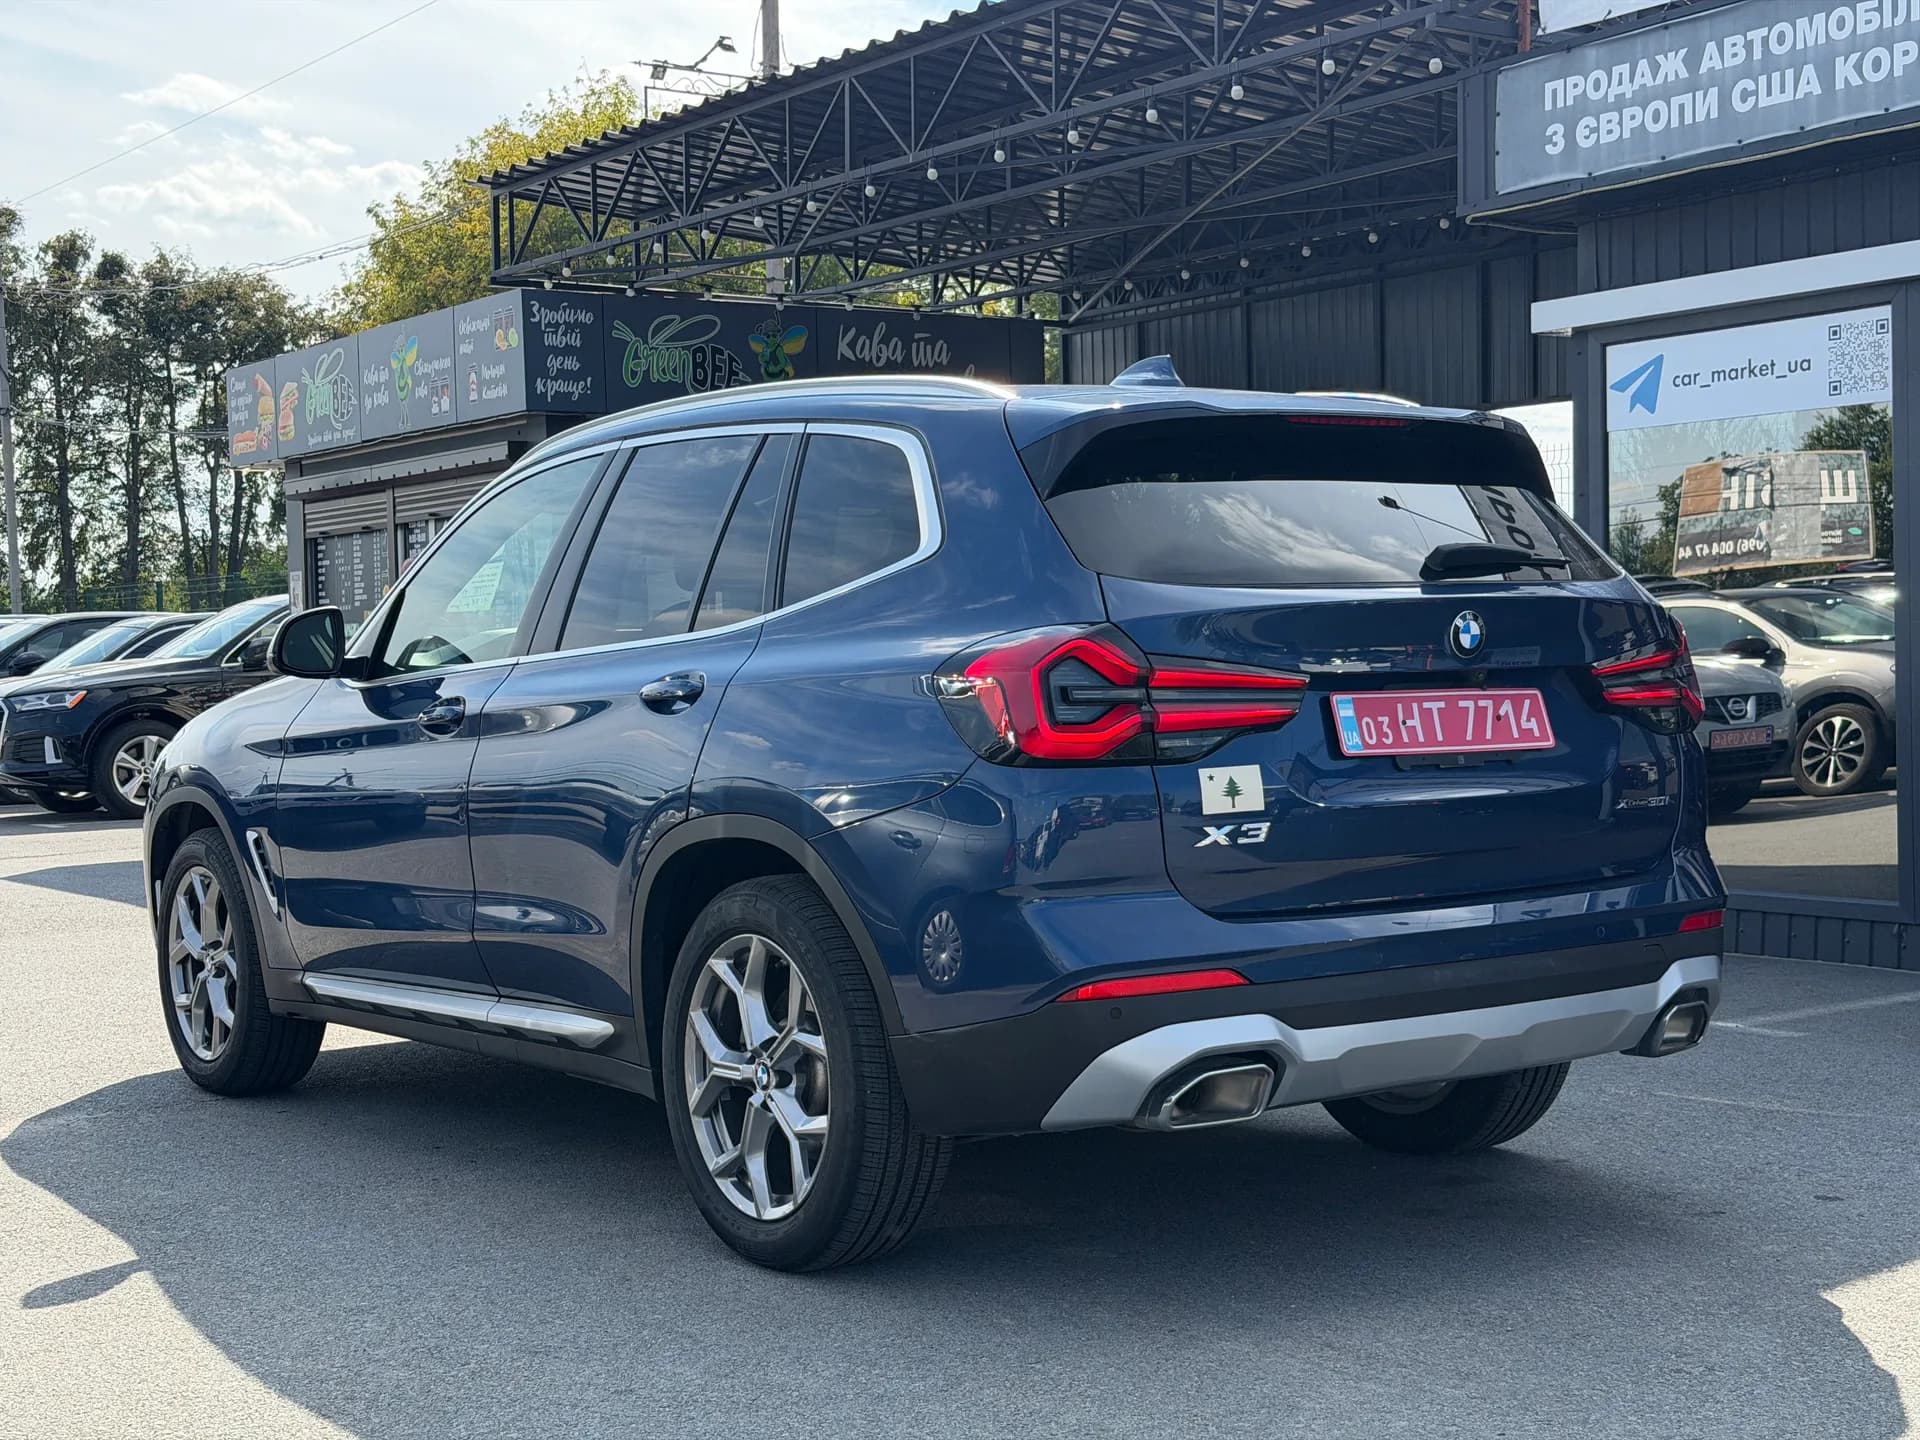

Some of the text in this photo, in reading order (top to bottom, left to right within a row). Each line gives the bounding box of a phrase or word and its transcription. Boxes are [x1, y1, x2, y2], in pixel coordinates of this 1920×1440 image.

[1544, 47, 1690, 112] ПРОДАЖ
[1544, 40, 1919, 156] З ЄВРОПИ США КОР
[529, 300, 595, 331] Зробимо
[543, 324, 583, 349] твій
[836, 321, 951, 368] Кава та
[546, 353, 581, 377] день
[1672, 358, 1812, 389] car_market_ua
[534, 376, 593, 403] краще!
[1361, 699, 1540, 745] 03 HT 7714
[1344, 731, 1361, 745] UA
[1193, 822, 1272, 848] X3
